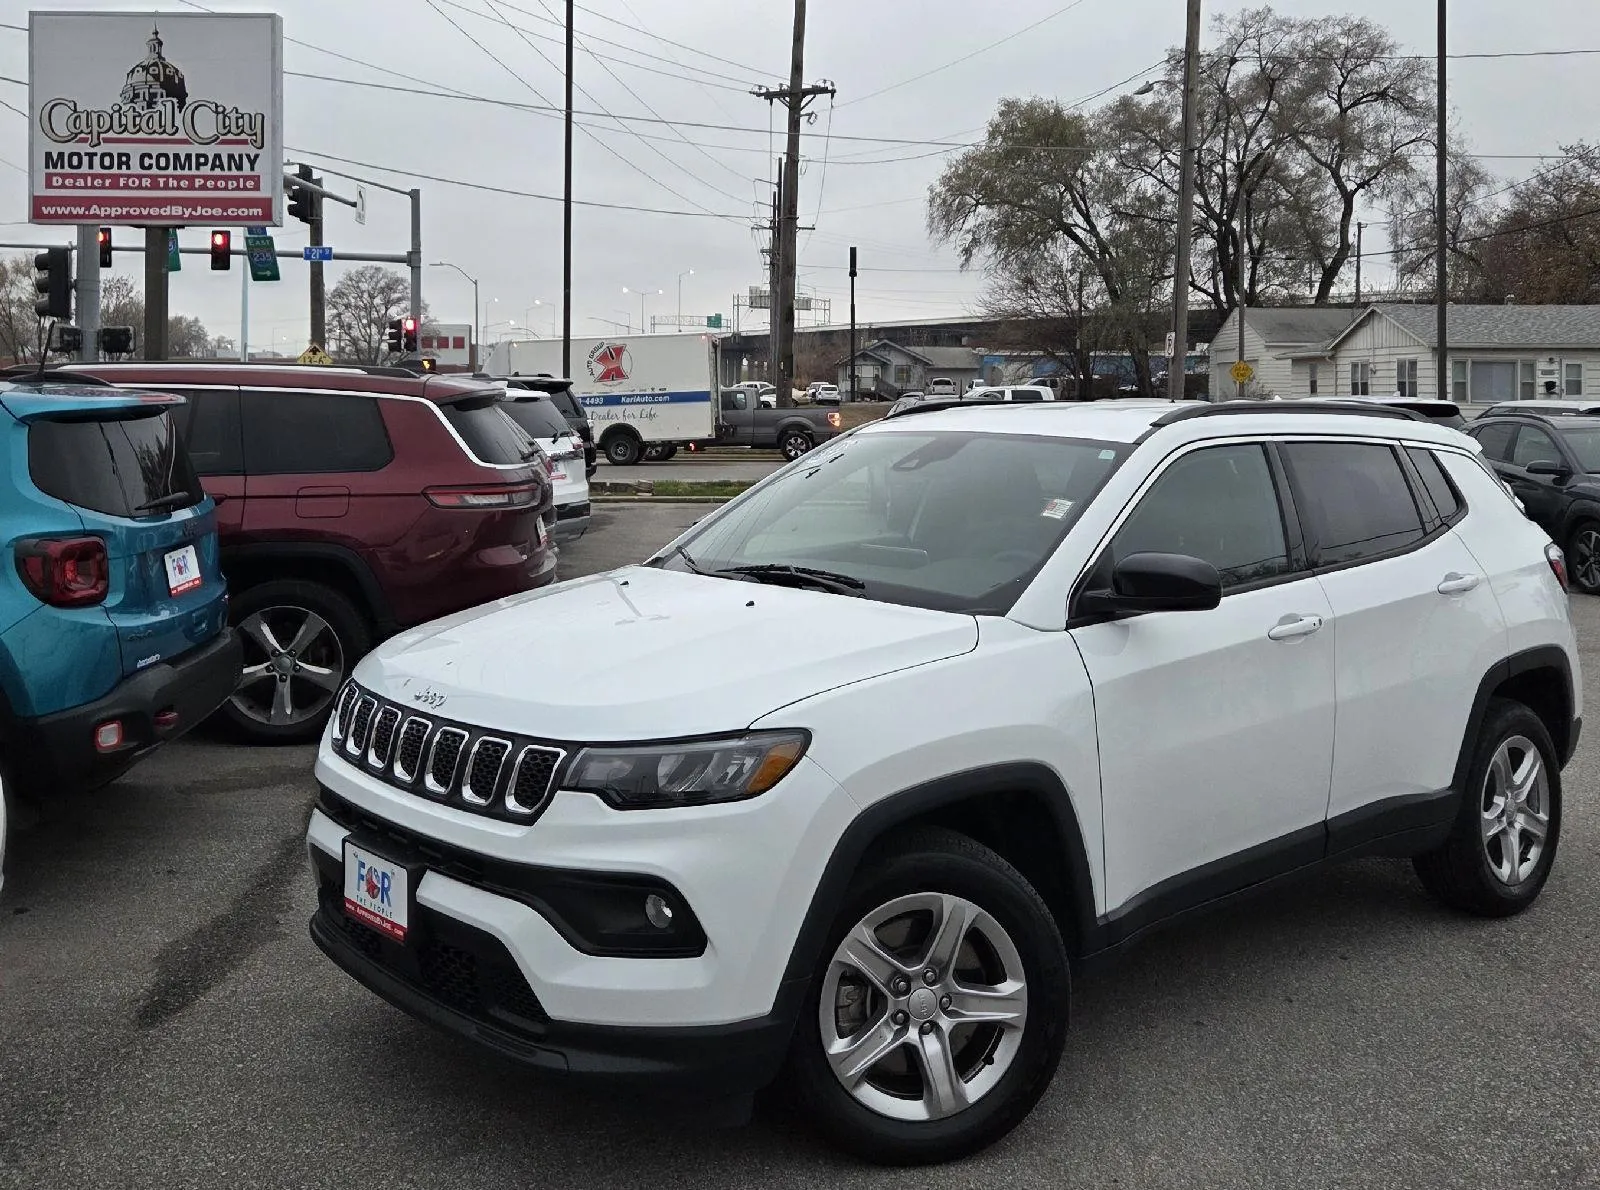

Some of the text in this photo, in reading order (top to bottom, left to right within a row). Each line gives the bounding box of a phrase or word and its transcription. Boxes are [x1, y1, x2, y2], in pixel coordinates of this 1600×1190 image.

[40, 98, 265, 149] Capital City
[44, 151, 261, 172] MOTOR COMPANY
[52, 176, 255, 190] Dealer FOR The People
[41, 204, 263, 218] www.ApprovedByJoe.com
[590, 410, 621, 421] Dealer
[622, 408, 636, 421] for
[357, 859, 392, 908] FOR
[369, 901, 393, 919] PEOPLE
